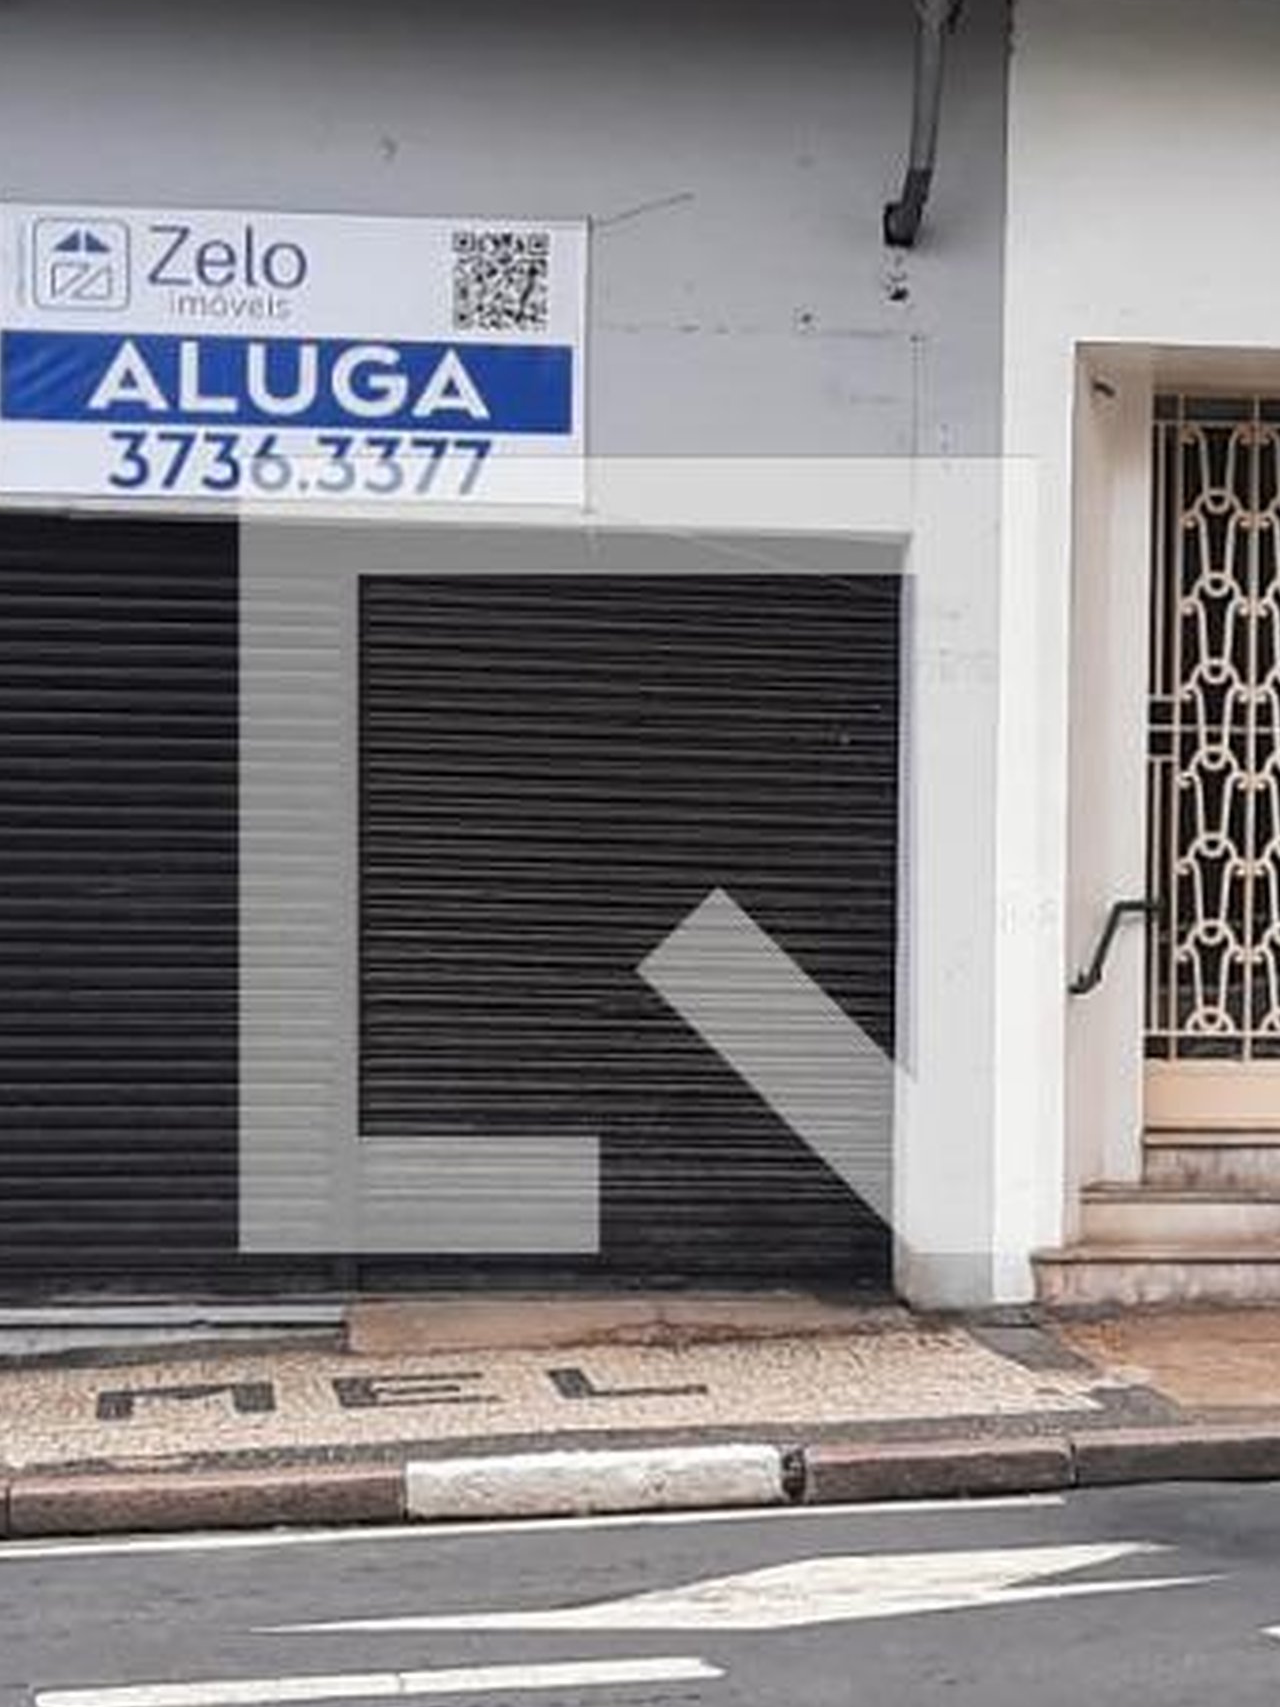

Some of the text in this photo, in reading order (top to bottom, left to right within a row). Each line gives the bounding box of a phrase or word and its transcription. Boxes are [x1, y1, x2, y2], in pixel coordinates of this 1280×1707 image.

[147, 223, 308, 291] Zelo
[87, 339, 491, 420] ALUGA
[108, 430, 493, 496] 3736.3377
